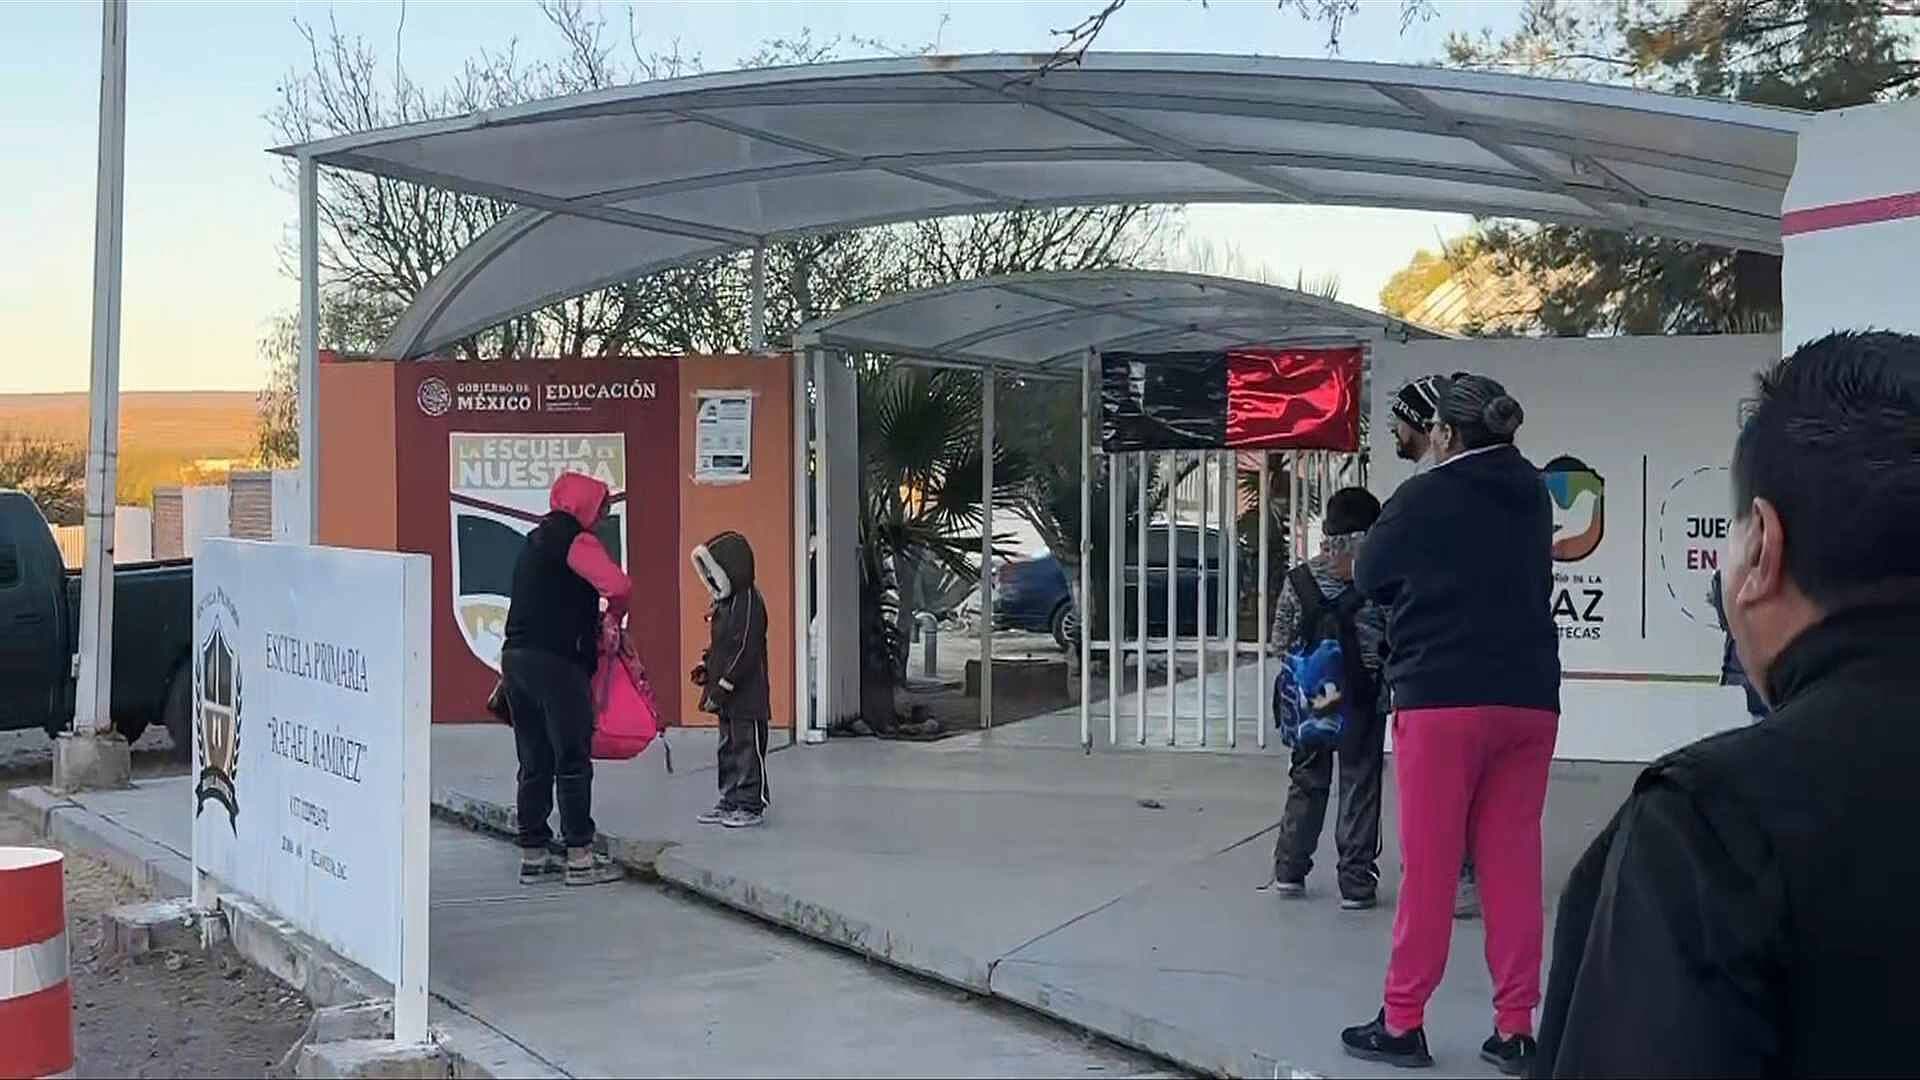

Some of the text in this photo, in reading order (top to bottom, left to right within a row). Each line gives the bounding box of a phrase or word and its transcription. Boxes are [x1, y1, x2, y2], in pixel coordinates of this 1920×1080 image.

[457, 383, 513, 392] GOBIERNO
[546, 379, 656, 400] EDUCACIÓN
[457, 393, 531, 410] MÉXICO
[484, 438, 593, 459] ESCUELA
[1686, 517, 1732, 539] JUE
[1686, 549, 1718, 570] EN
[1588, 575, 1602, 584] LA
[1552, 588, 1604, 622] AZ
[266, 633, 369, 693] ESCUELA PRIMARIA
